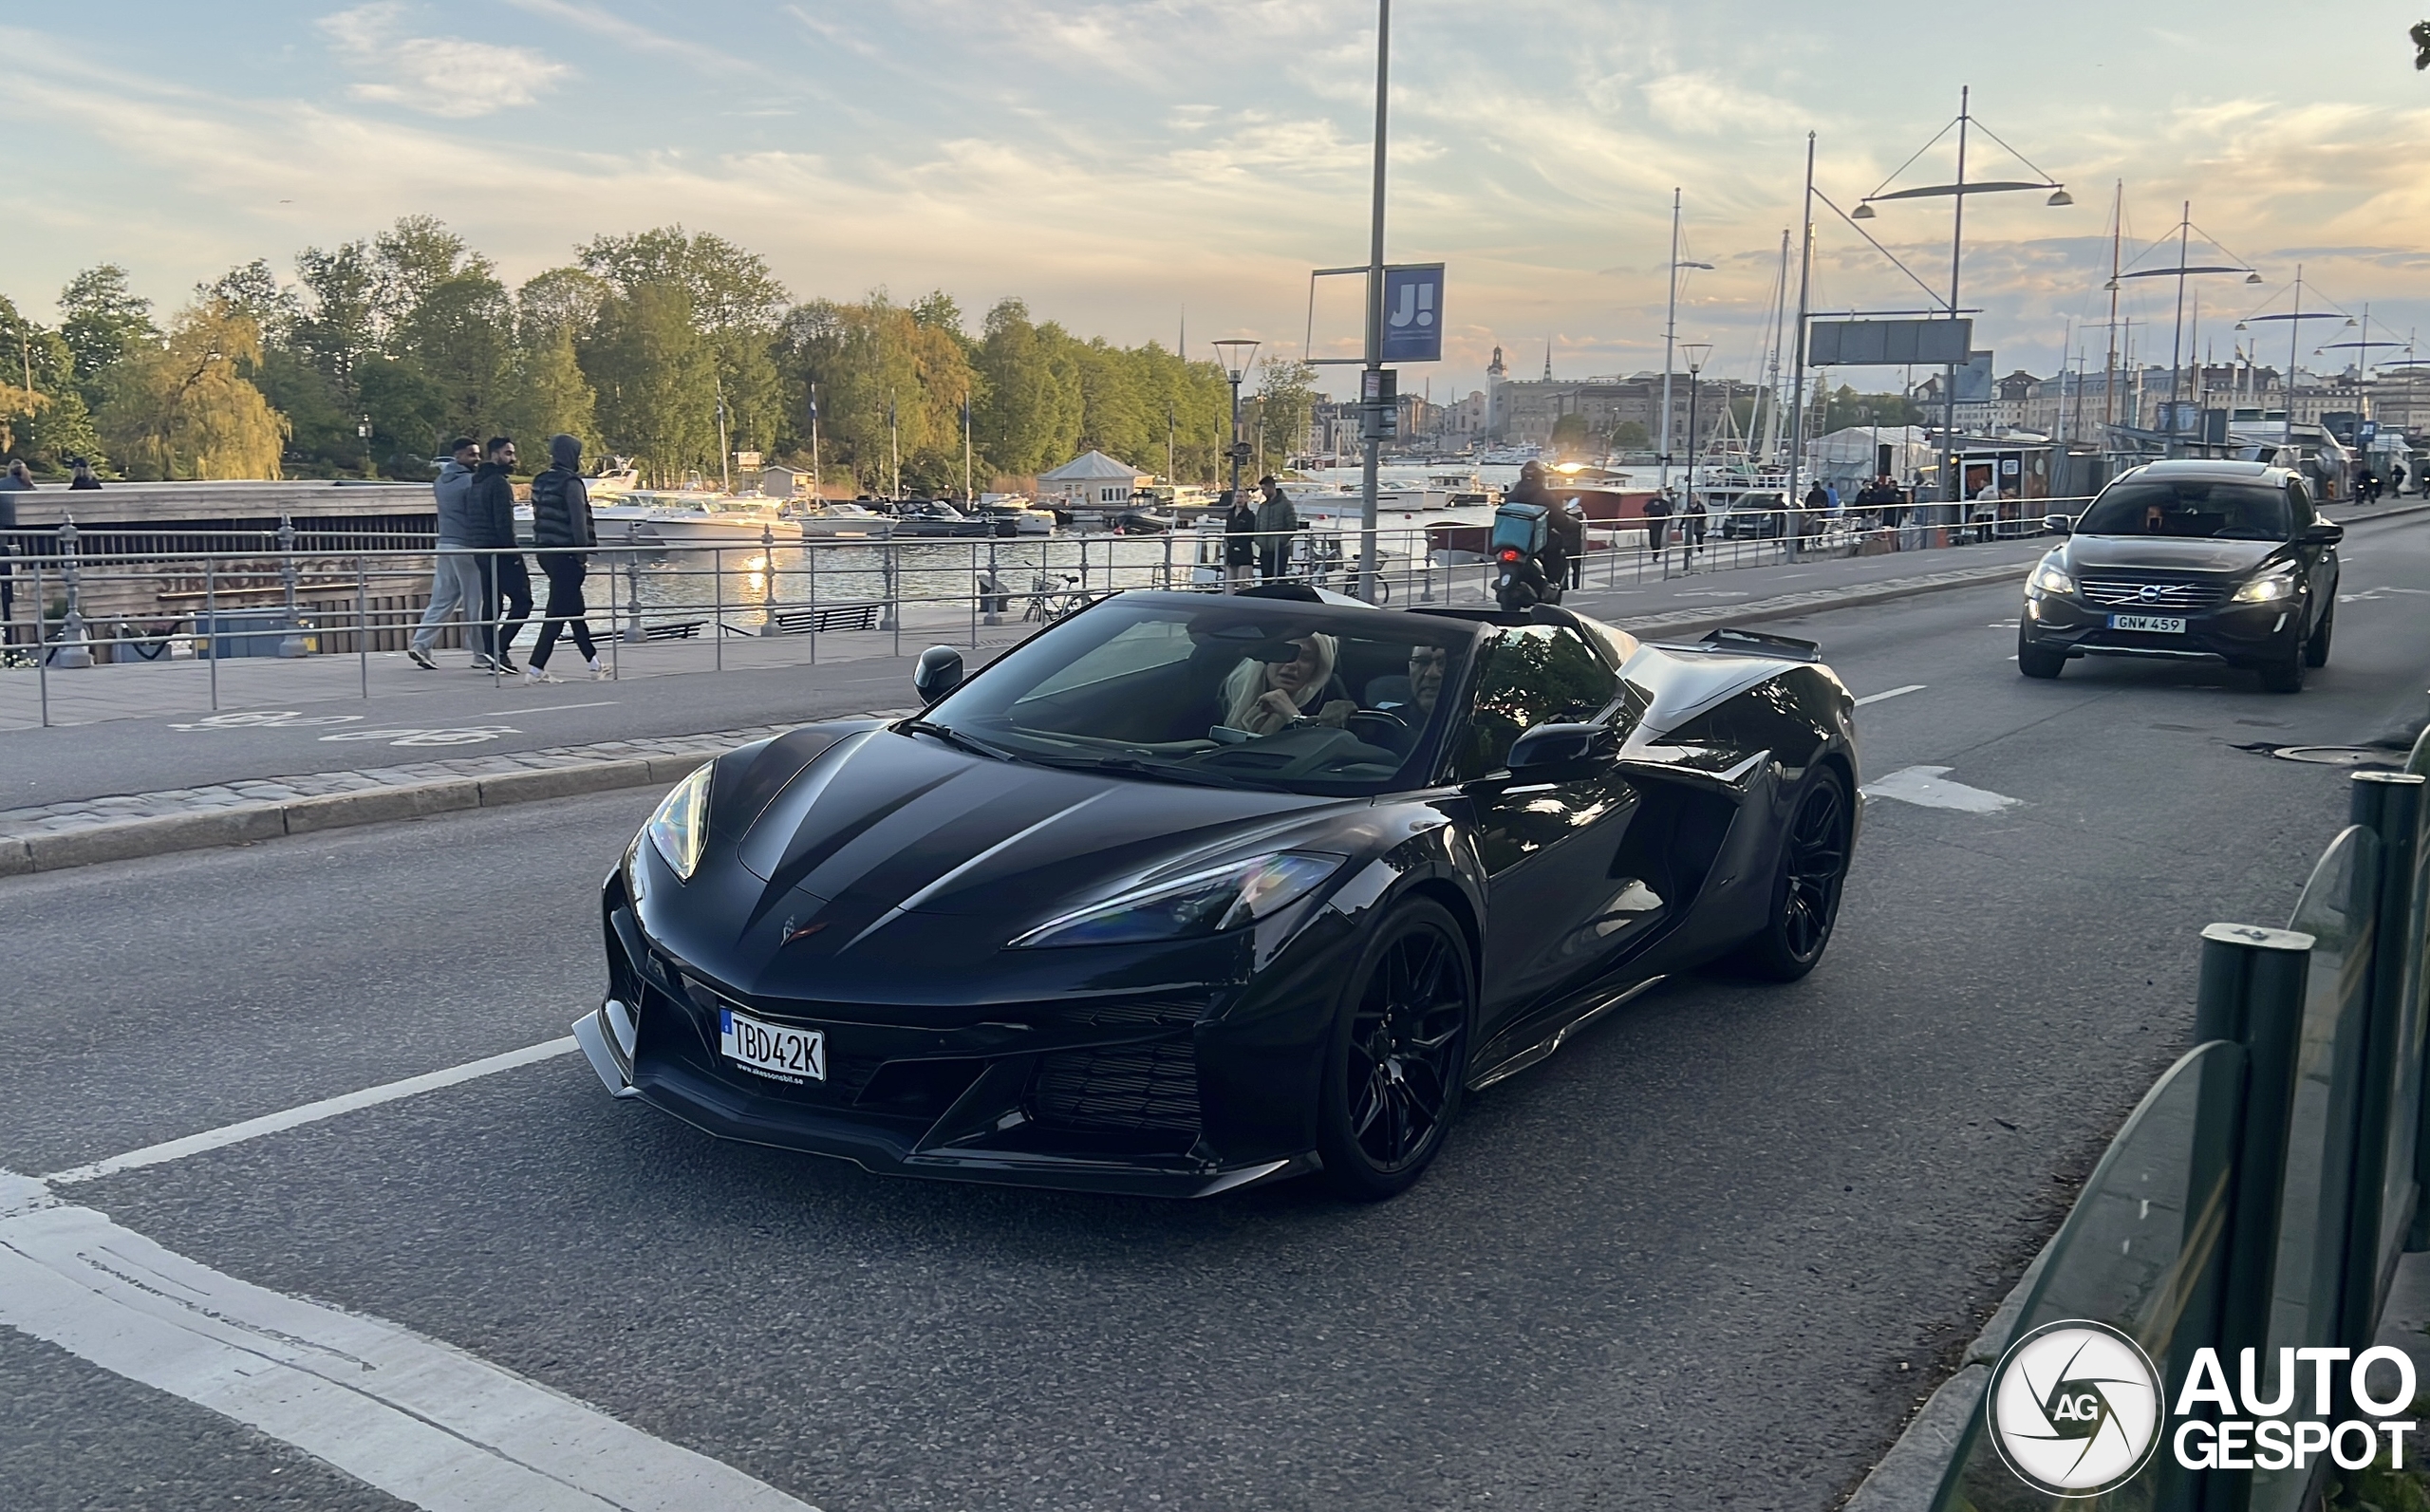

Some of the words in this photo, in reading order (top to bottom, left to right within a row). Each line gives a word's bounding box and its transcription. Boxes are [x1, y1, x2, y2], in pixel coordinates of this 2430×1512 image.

[1389, 283, 1434, 327] J!
[2119, 616, 2147, 629] GNW
[2150, 618, 2179, 631] 459
[733, 1018, 820, 1074] TBD42K
